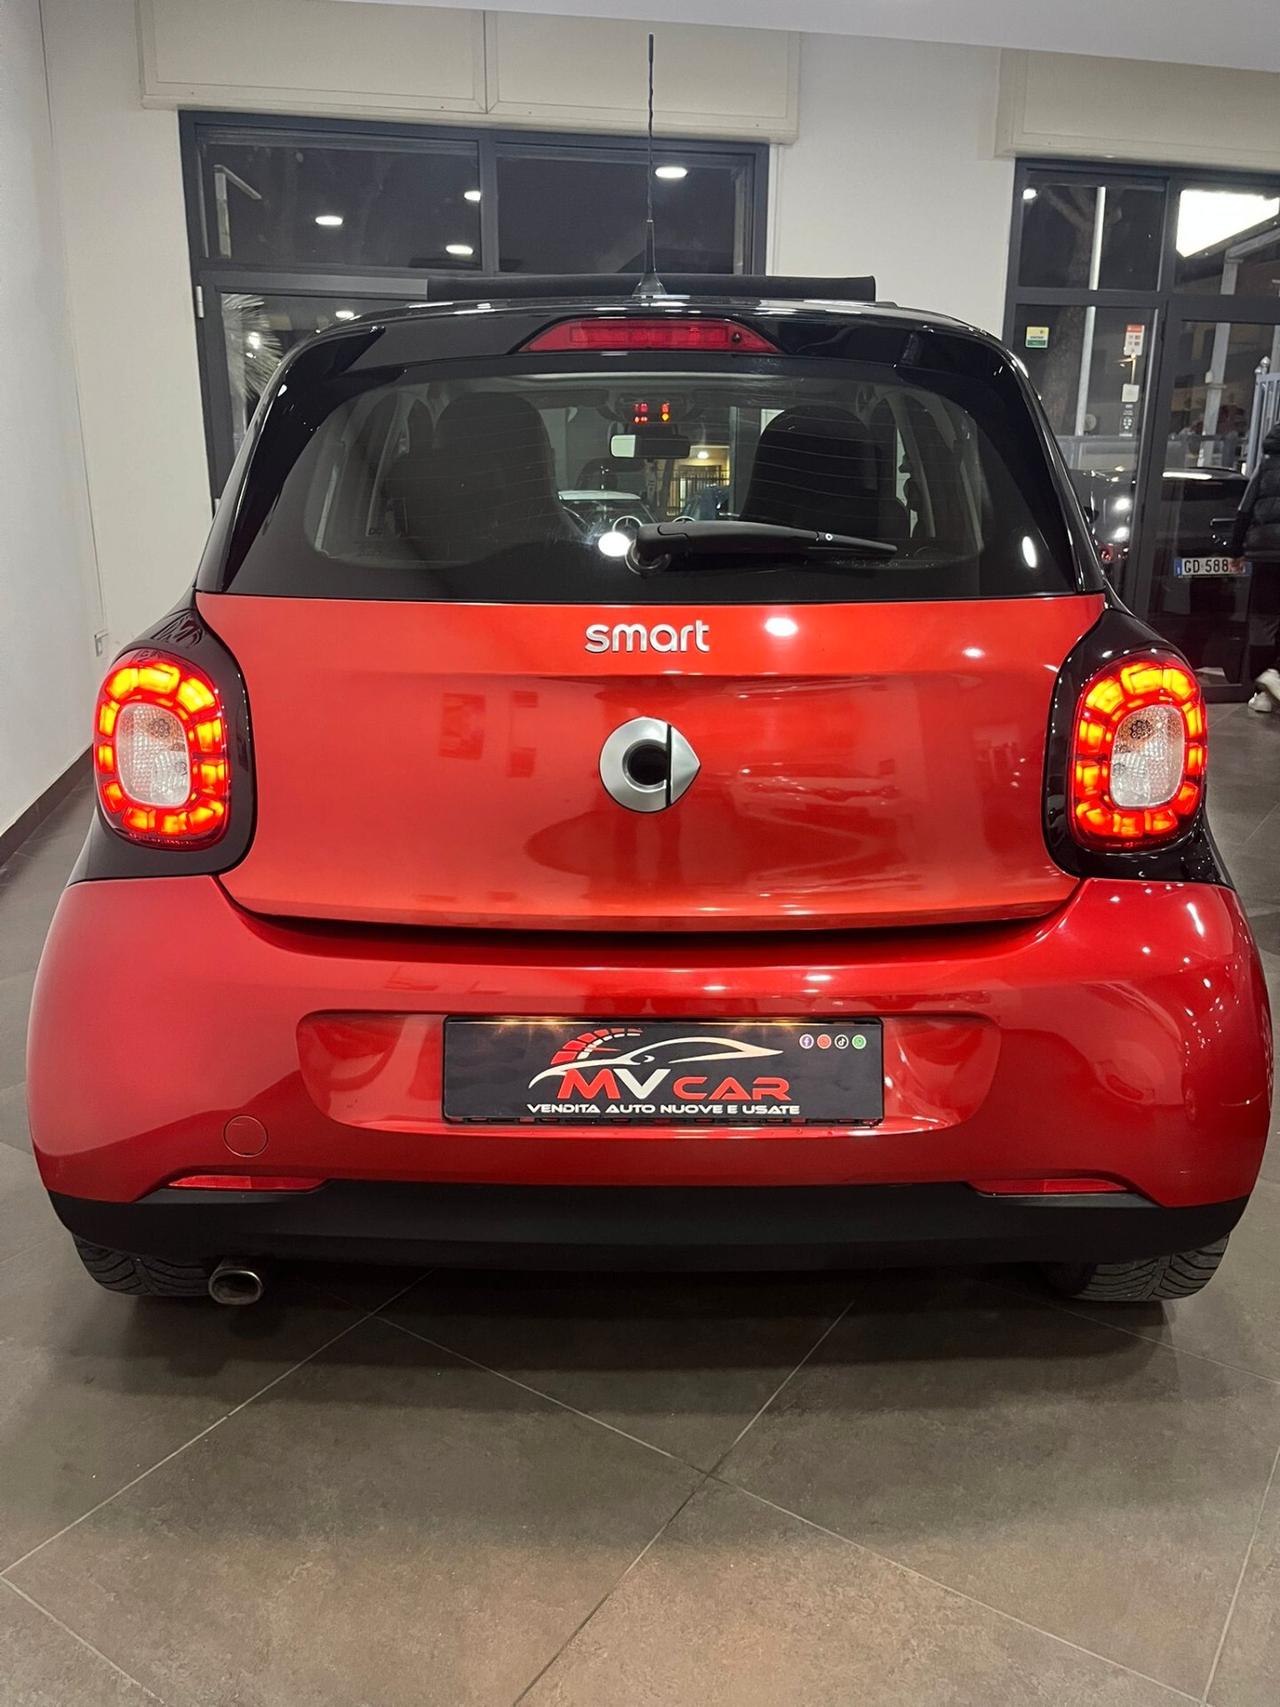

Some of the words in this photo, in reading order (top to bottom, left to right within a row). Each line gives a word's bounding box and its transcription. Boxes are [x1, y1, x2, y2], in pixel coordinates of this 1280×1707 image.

[1184, 559, 1200, 573] GD
[584, 619, 710, 653] smart
[672, 1076, 792, 1101] CAR
[527, 1104, 601, 1113] VENDITA
[605, 1104, 656, 1114] AUTO
[660, 1104, 724, 1114] NUOVE
[727, 1104, 738, 1114] E
[742, 1105, 800, 1115] USATE
